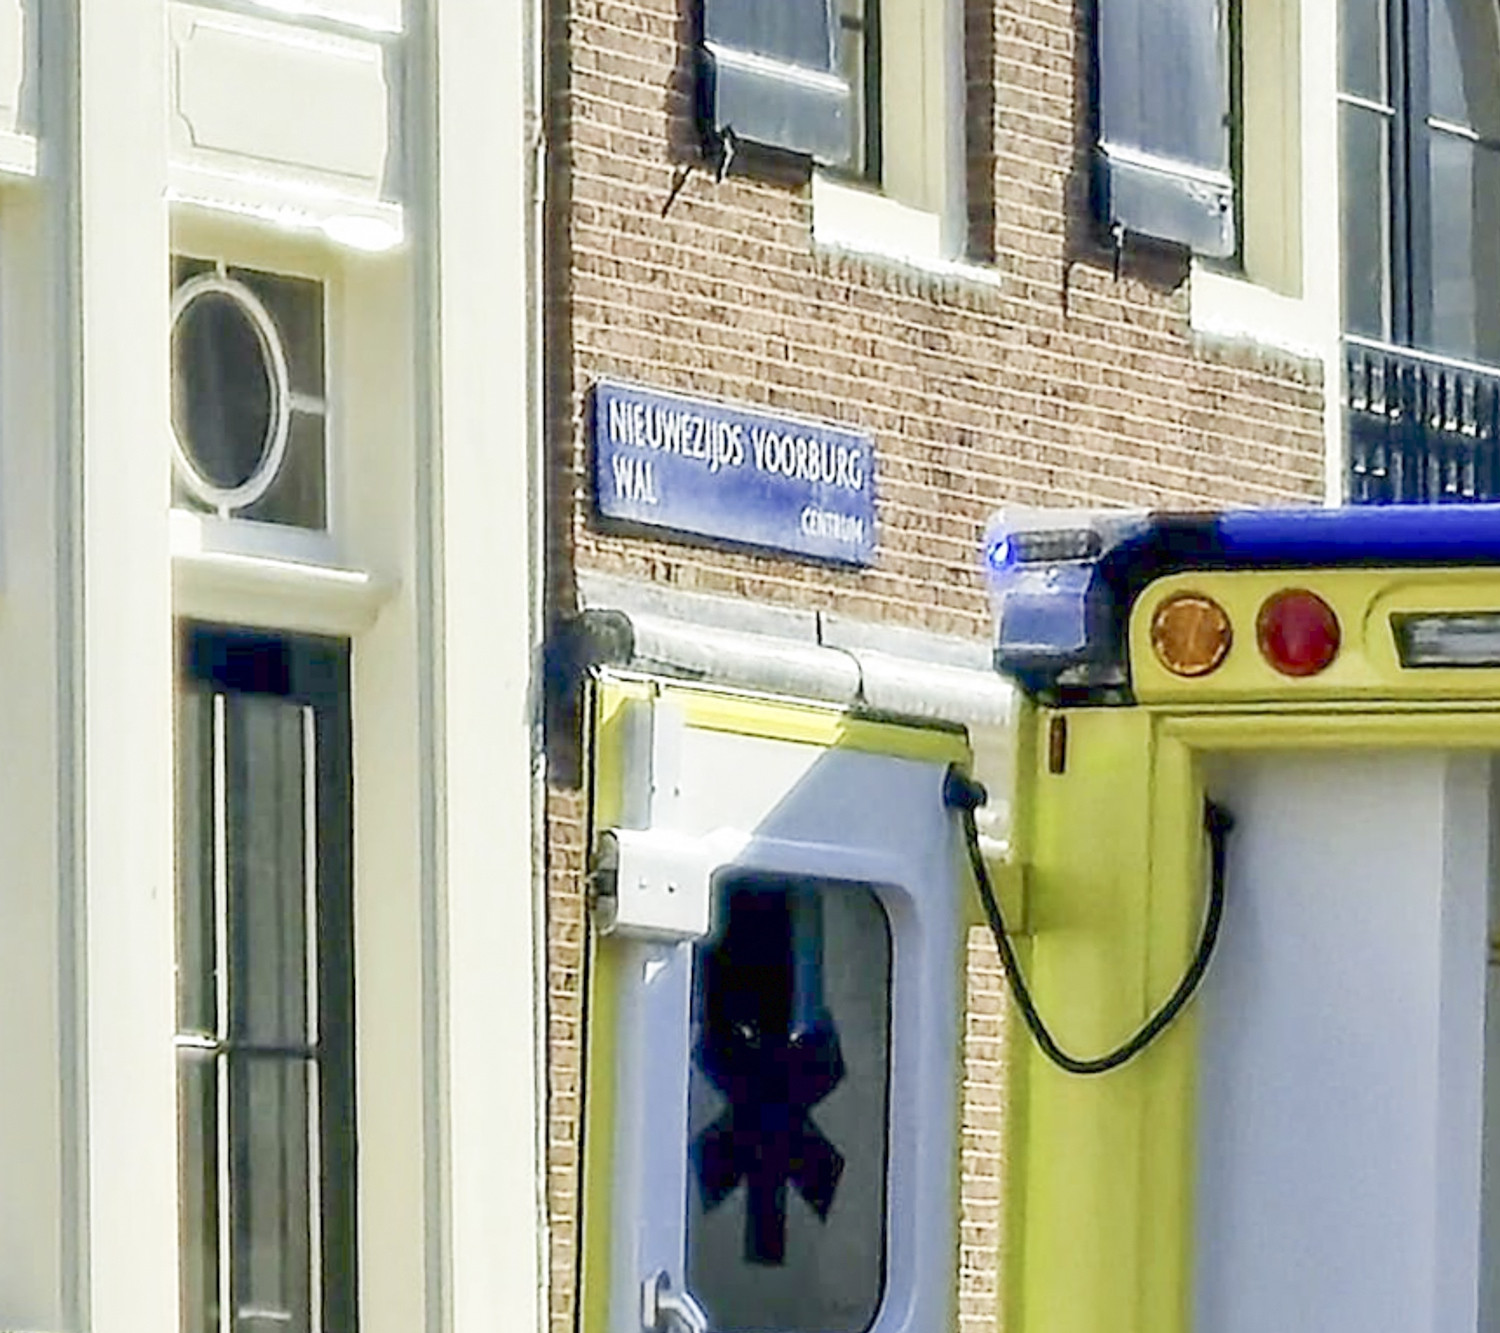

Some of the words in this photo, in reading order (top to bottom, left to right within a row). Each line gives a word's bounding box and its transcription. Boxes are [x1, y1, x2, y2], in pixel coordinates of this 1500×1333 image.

[608, 398, 745, 474] NIEUWEZIJDS
[752, 425, 864, 490] VOORBURG
[612, 453, 658, 504] WAL
[802, 505, 865, 543] CENTRUM
